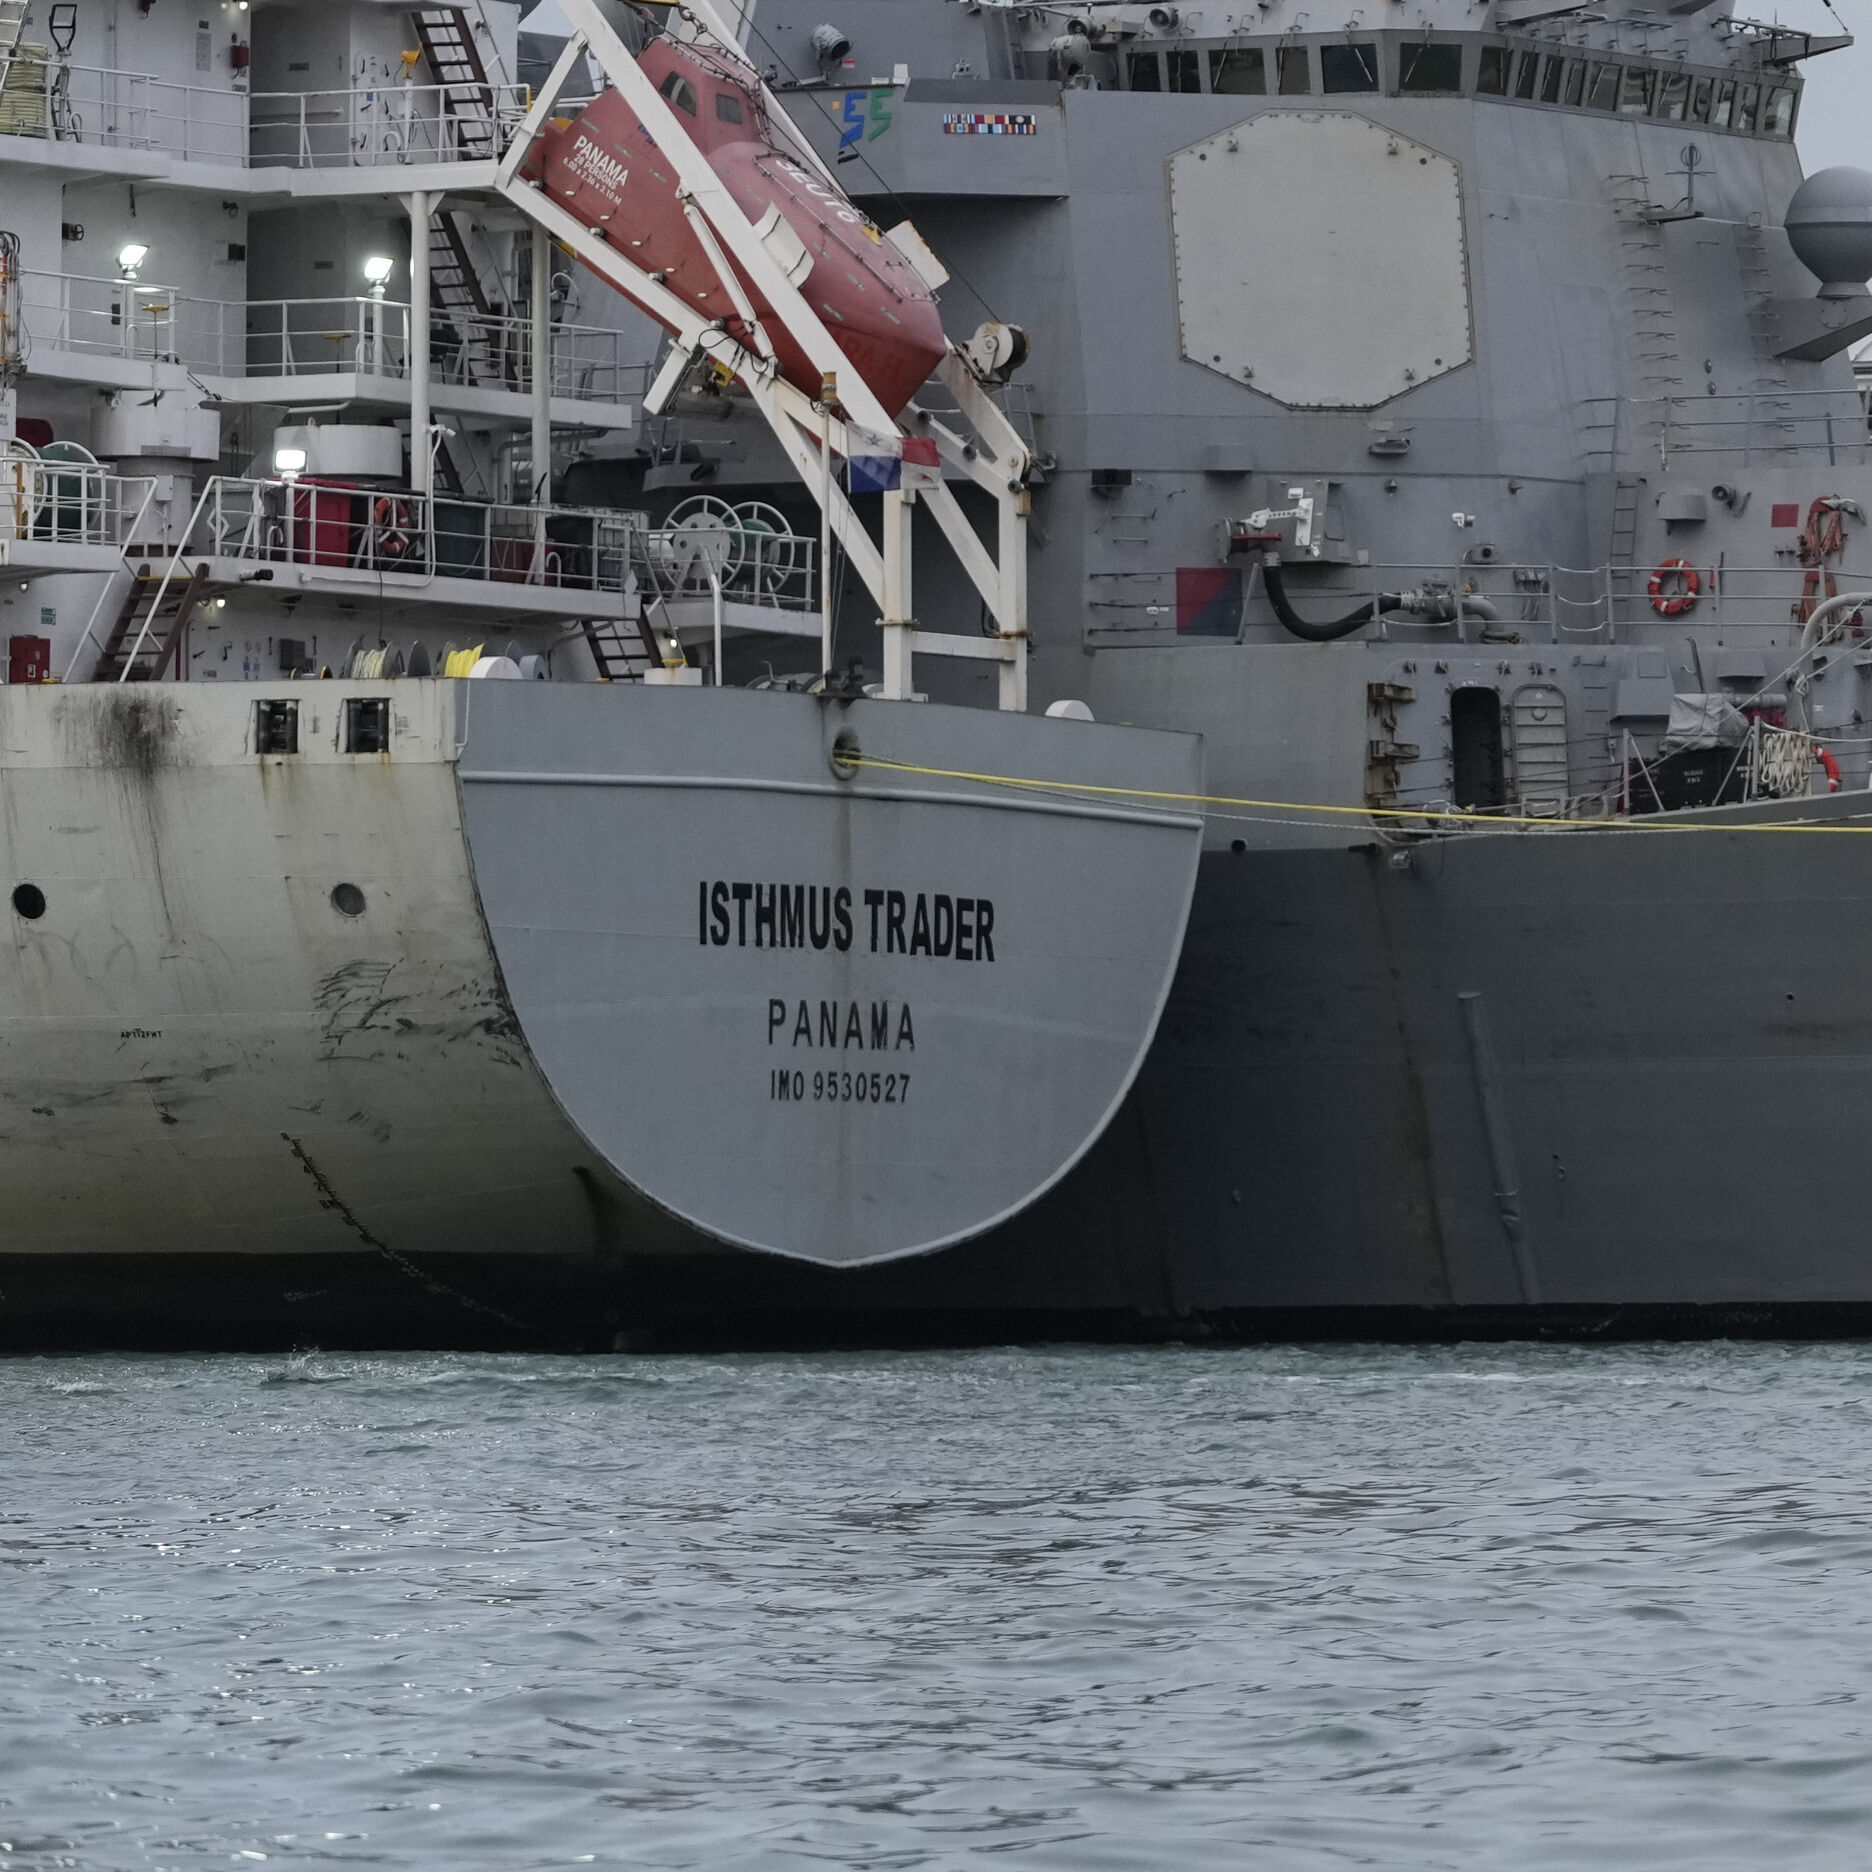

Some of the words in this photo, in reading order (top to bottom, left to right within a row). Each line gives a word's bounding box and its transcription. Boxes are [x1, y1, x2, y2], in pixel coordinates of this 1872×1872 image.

[573, 135, 629, 187] PANAMA
[574, 153, 585, 165] 28
[583, 158, 619, 190] PERSONS
[699, 880, 853, 952] ISTHMUS
[864, 889, 995, 962] TRADER
[768, 998, 915, 1051] PANAMA
[771, 1069, 805, 1101] IMO
[813, 1070, 910, 1104] 9530527
